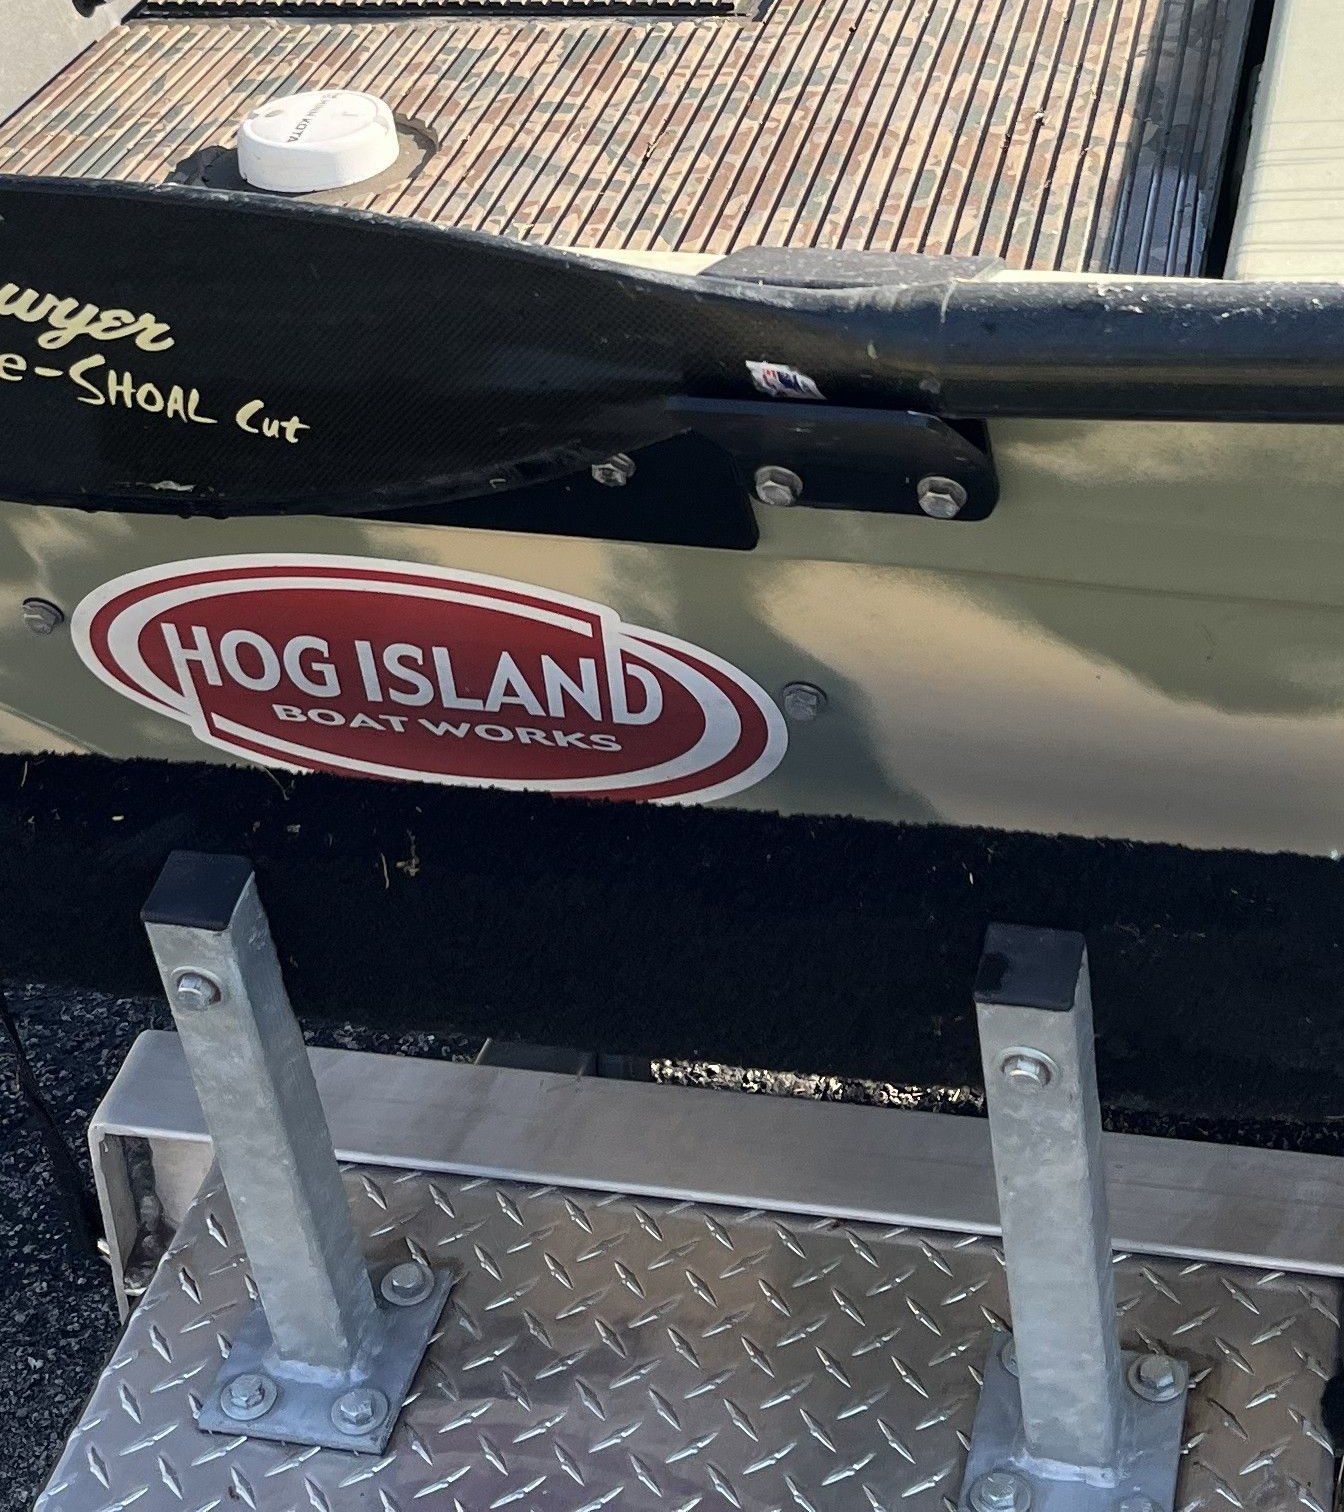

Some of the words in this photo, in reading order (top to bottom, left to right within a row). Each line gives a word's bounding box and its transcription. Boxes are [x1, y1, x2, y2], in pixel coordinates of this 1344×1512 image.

[287, 118, 310, 143] KOTA
[235, 399, 311, 443] Cut
[161, 622, 342, 698] HOG
[354, 638, 664, 725] ISLAND
[271, 703, 409, 734] BOAT
[418, 718, 624, 752] WORKS
